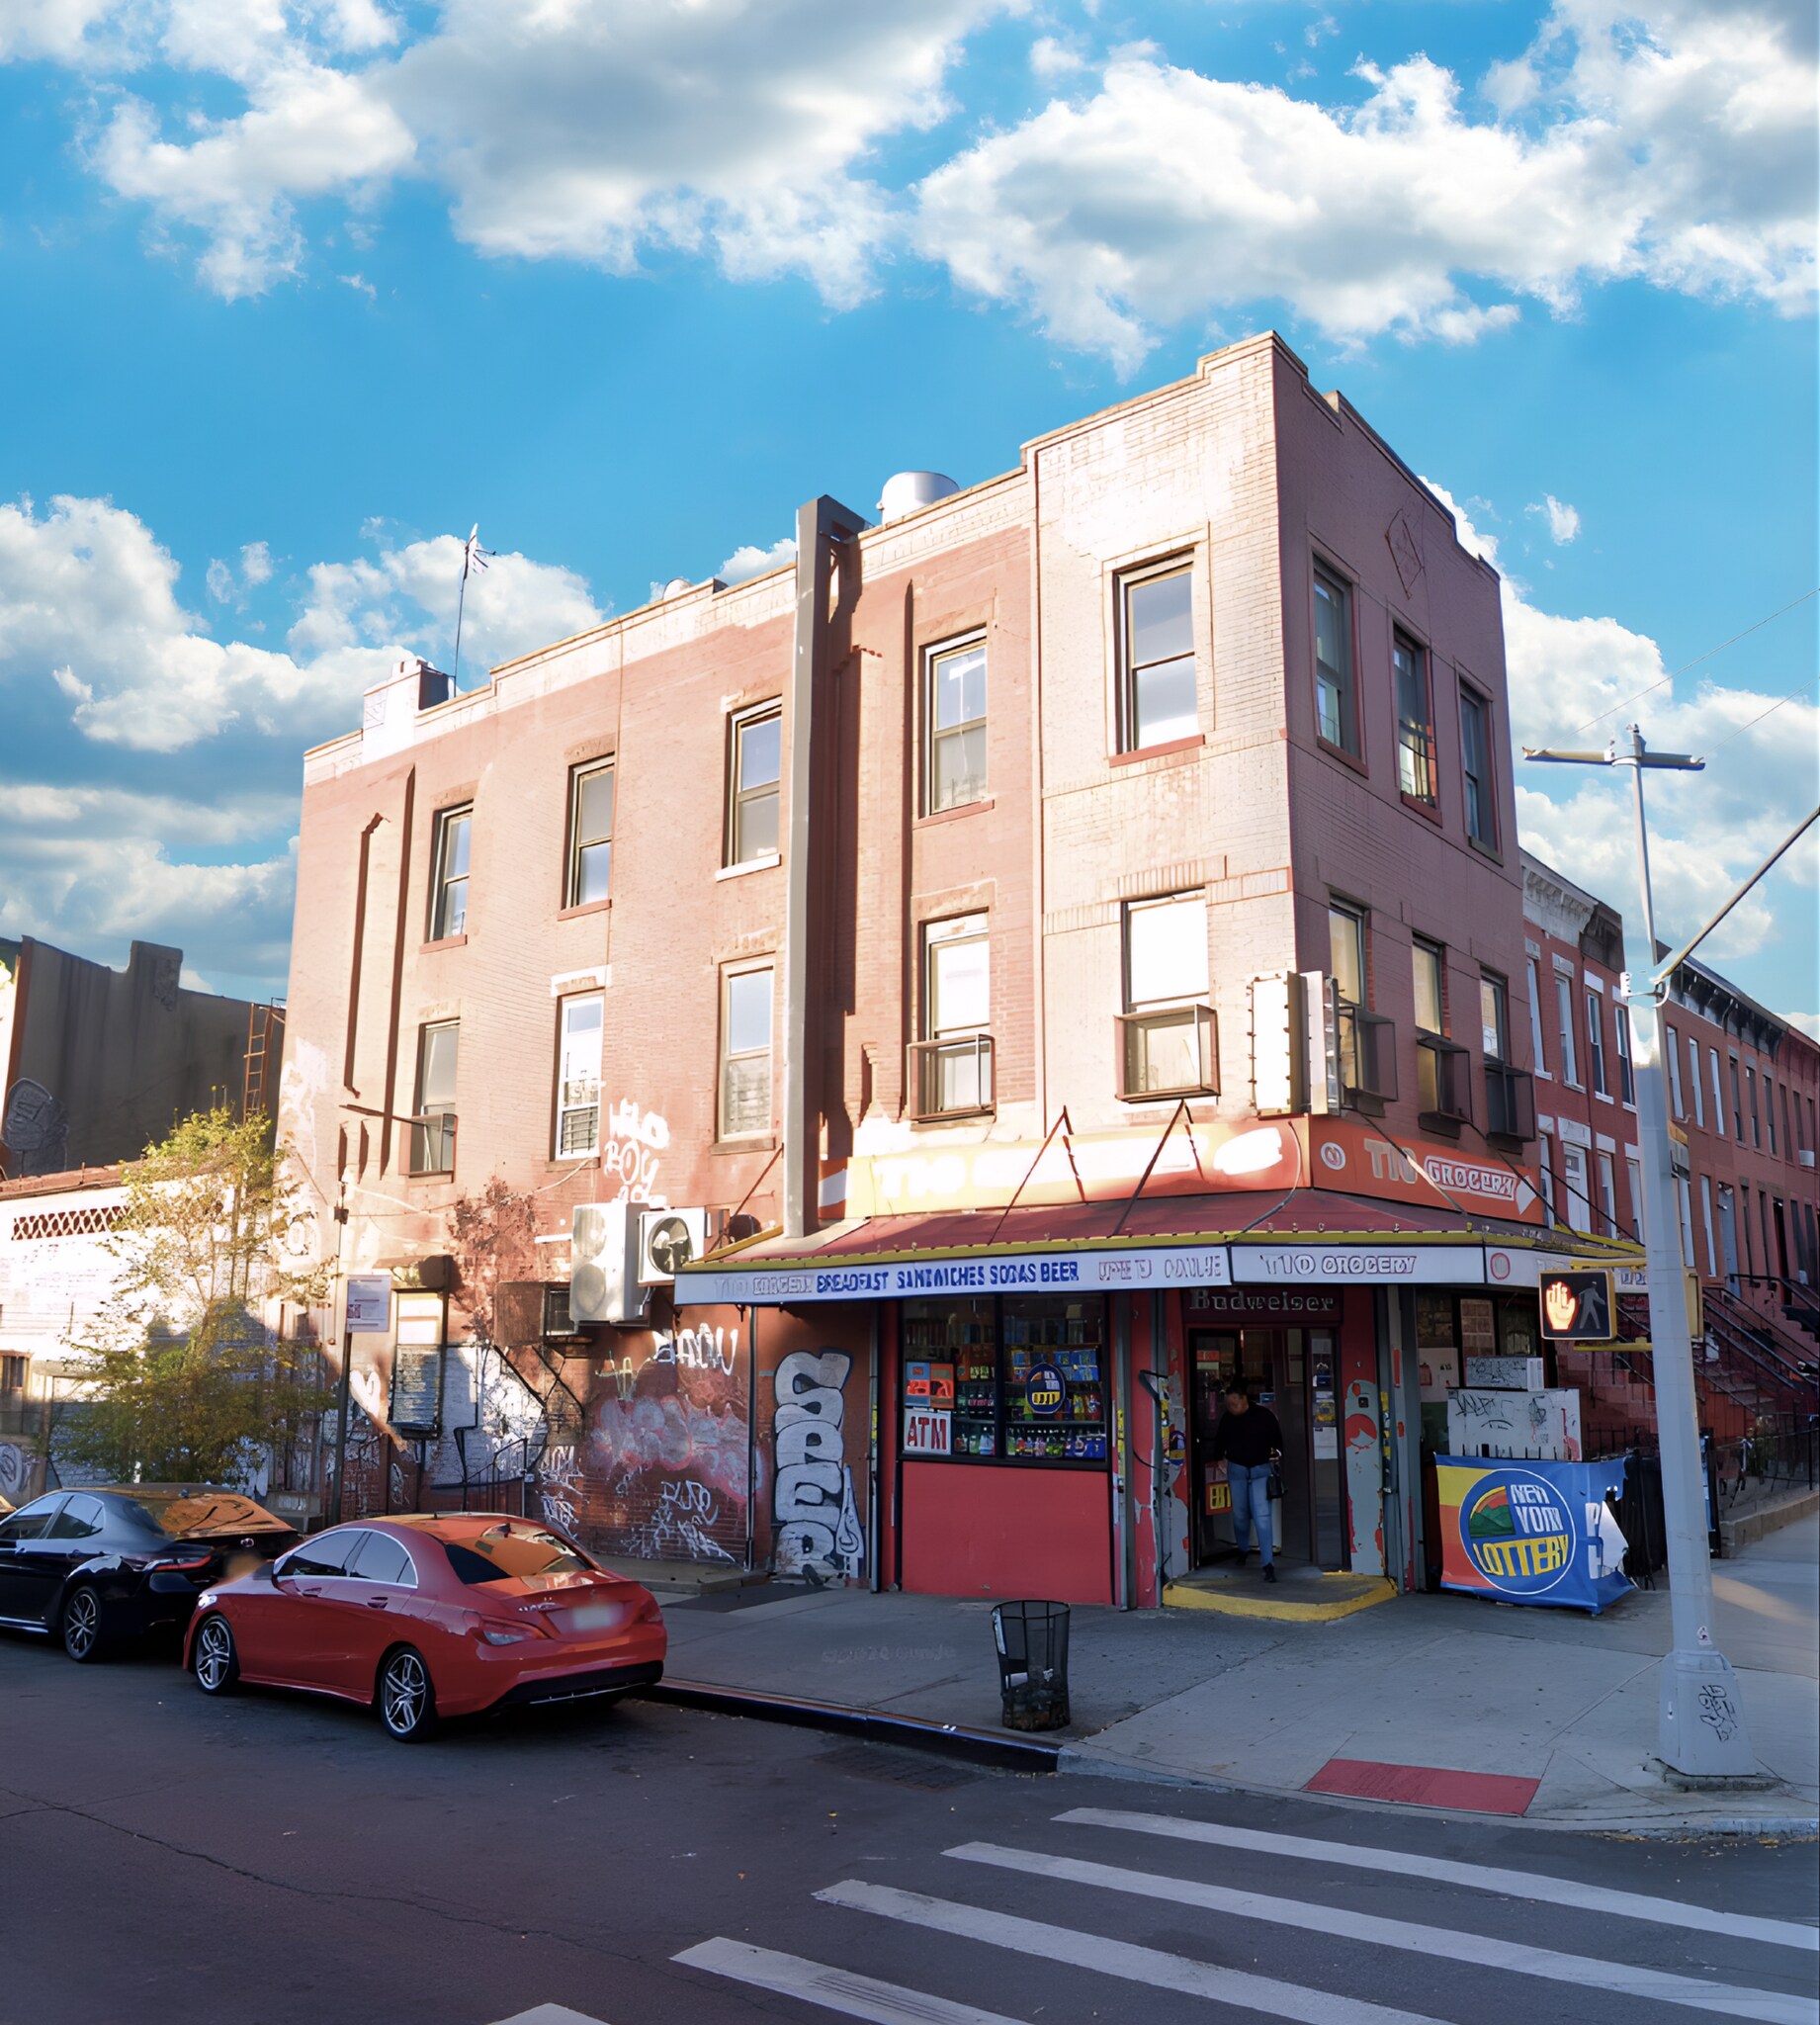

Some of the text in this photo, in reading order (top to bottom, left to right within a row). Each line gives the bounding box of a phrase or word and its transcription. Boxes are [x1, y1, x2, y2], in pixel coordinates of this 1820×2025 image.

[1041, 1261, 1080, 1282] BEER
[1189, 1288, 1335, 1311] Budweiser
[907, 1416, 947, 1451] ATM
[1472, 1534, 1569, 1577] LOTTERY
